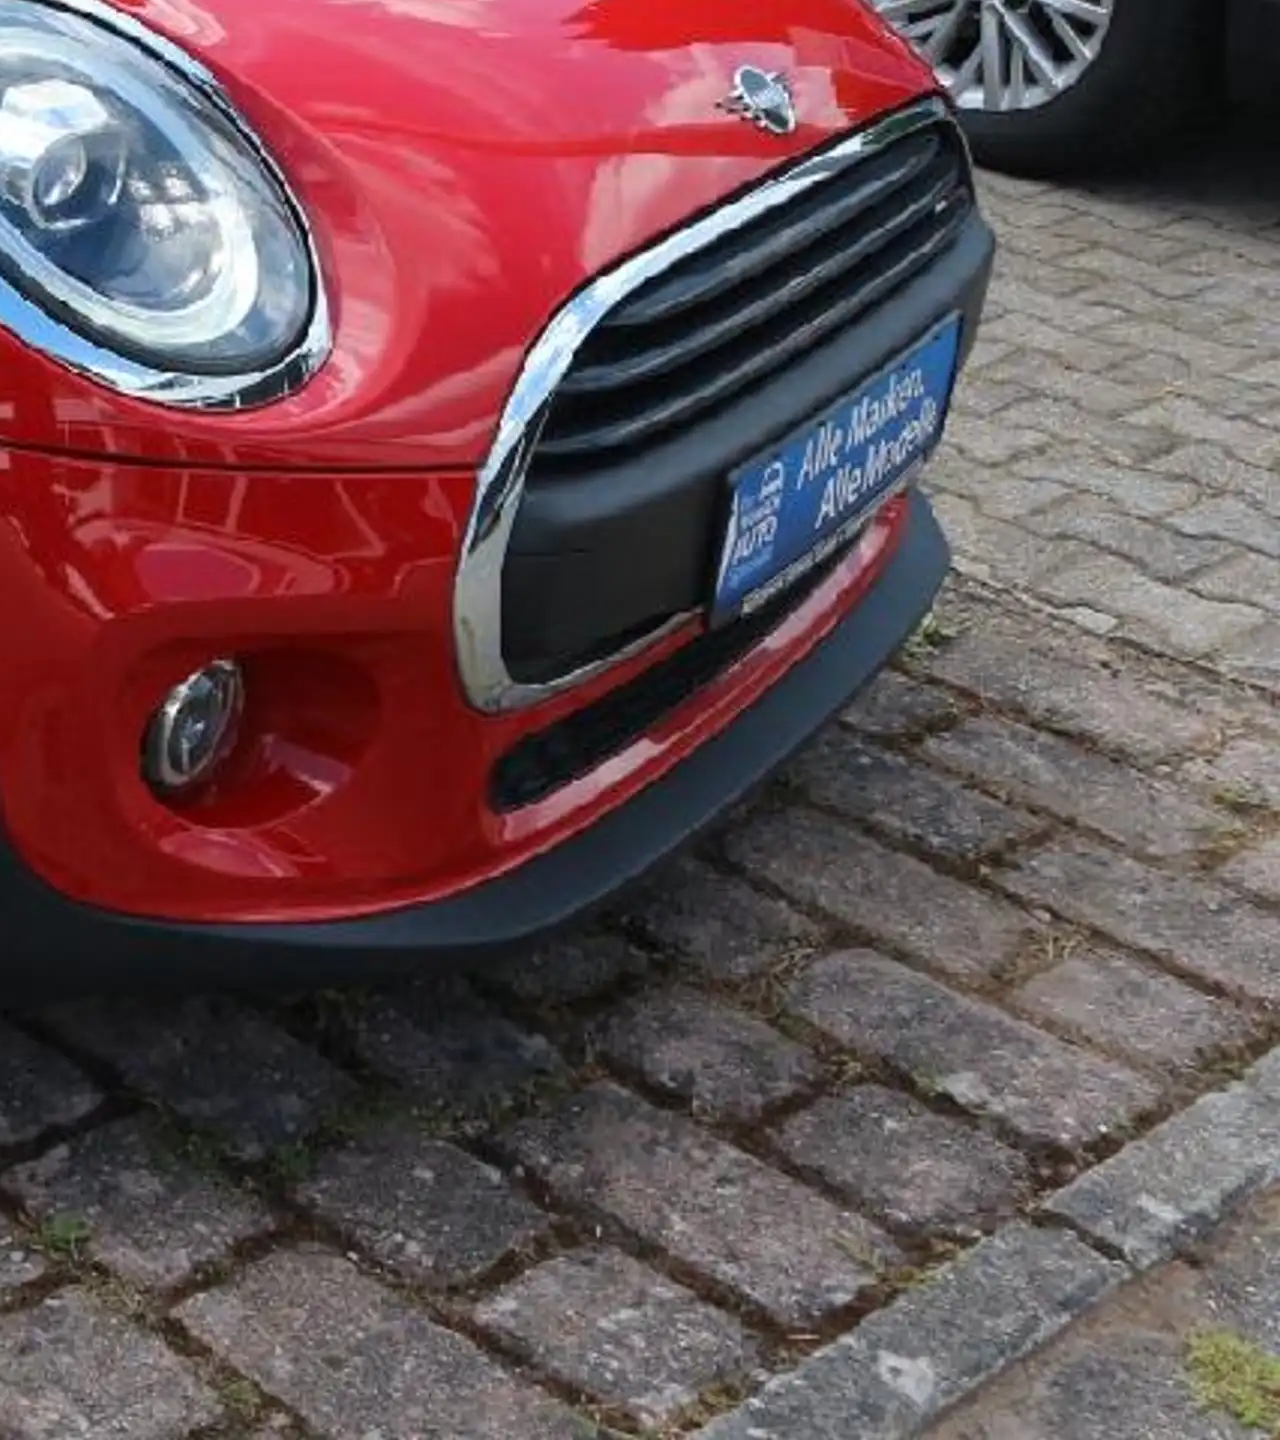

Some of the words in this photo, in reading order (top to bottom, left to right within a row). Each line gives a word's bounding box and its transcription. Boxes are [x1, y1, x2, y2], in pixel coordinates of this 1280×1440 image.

[797, 421, 843, 491] Alle
[845, 368, 925, 454] Marken
[814, 462, 862, 529] Alle
